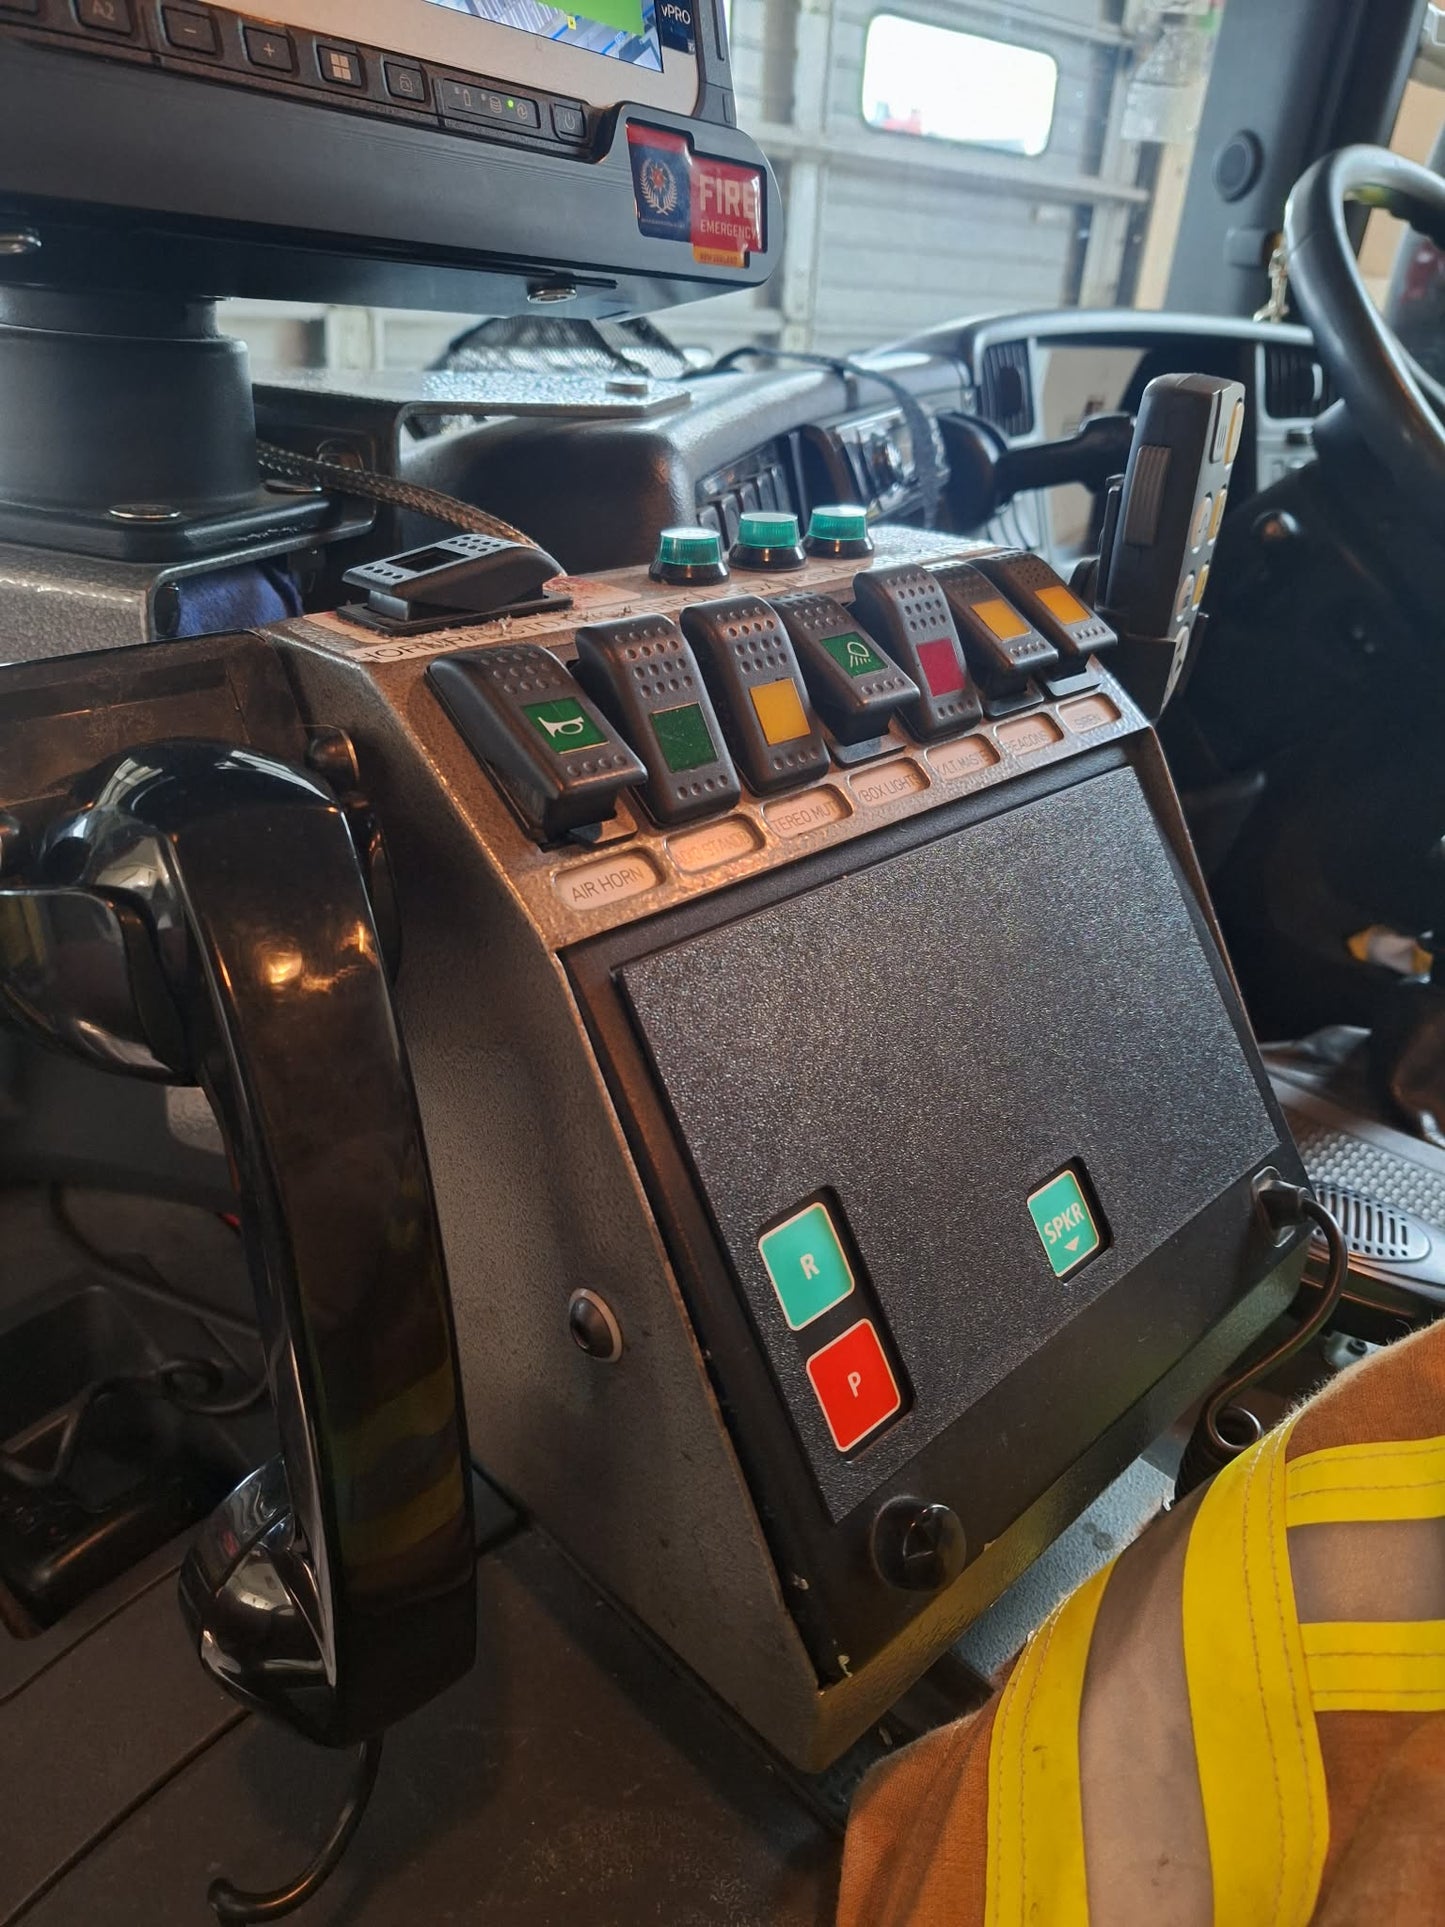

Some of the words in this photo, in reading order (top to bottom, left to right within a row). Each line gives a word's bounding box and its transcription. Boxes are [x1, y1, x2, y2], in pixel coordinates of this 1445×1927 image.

[661, 3, 691, 25] vPRO
[700, 174, 757, 219] FIRE
[701, 219, 758, 241] EMERGENCY
[884, 773, 921, 794] LIGHTS
[769, 809, 812, 833] TEREO
[811, 800, 837, 821] MUT
[571, 881, 600, 902] AIR
[597, 867, 646, 892] HORN
[1044, 1202, 1085, 1245] SPKR
[800, 1253, 820, 1280] R
[847, 1371, 861, 1398] P
